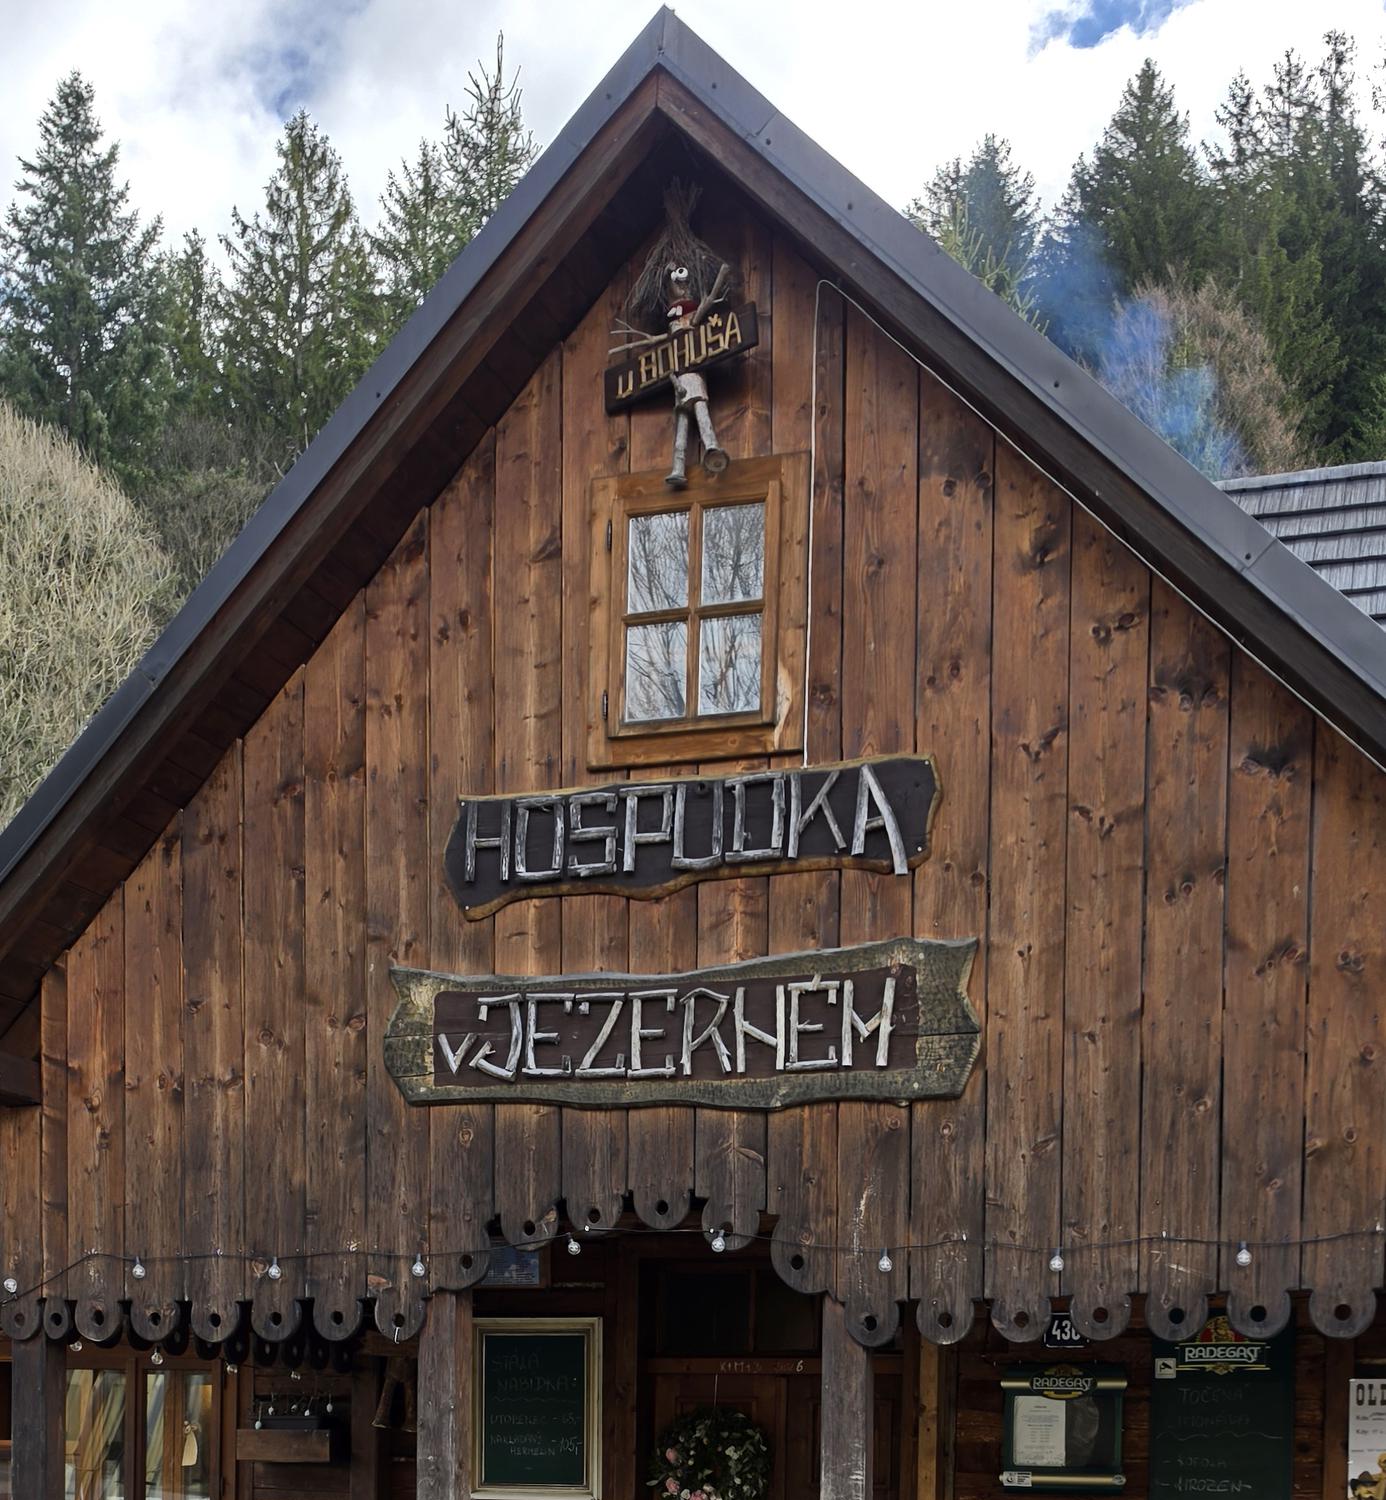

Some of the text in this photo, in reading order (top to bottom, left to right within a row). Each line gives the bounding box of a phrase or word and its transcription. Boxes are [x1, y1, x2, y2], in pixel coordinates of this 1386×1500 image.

[639, 311, 742, 389] BOHUŠA
[1185, 1346, 1262, 1363] RADEGAST
[1032, 1377, 1094, 1391] RADEGAST
